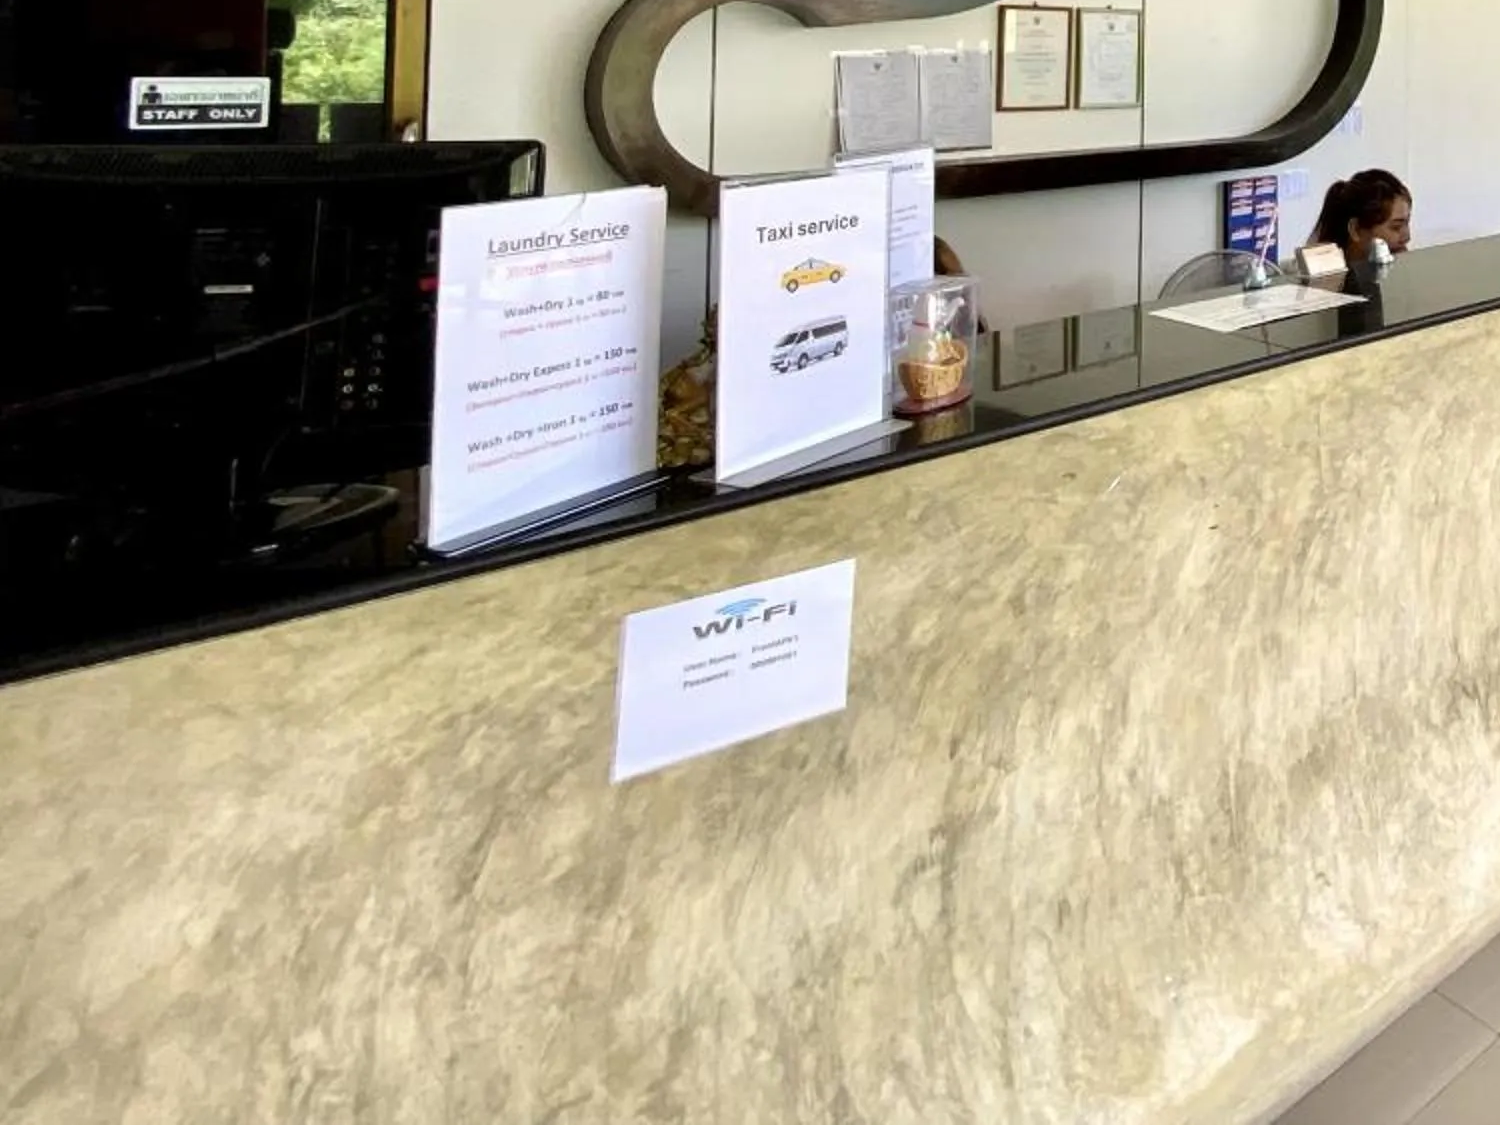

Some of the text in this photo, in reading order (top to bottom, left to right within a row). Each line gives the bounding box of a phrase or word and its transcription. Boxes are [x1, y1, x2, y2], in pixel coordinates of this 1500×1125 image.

[142, 108, 257, 120] STAFF ONLY
[488, 222, 631, 255] Laundry Service
[756, 213, 860, 244] Taxi service
[467, 436, 503, 455] Wash
